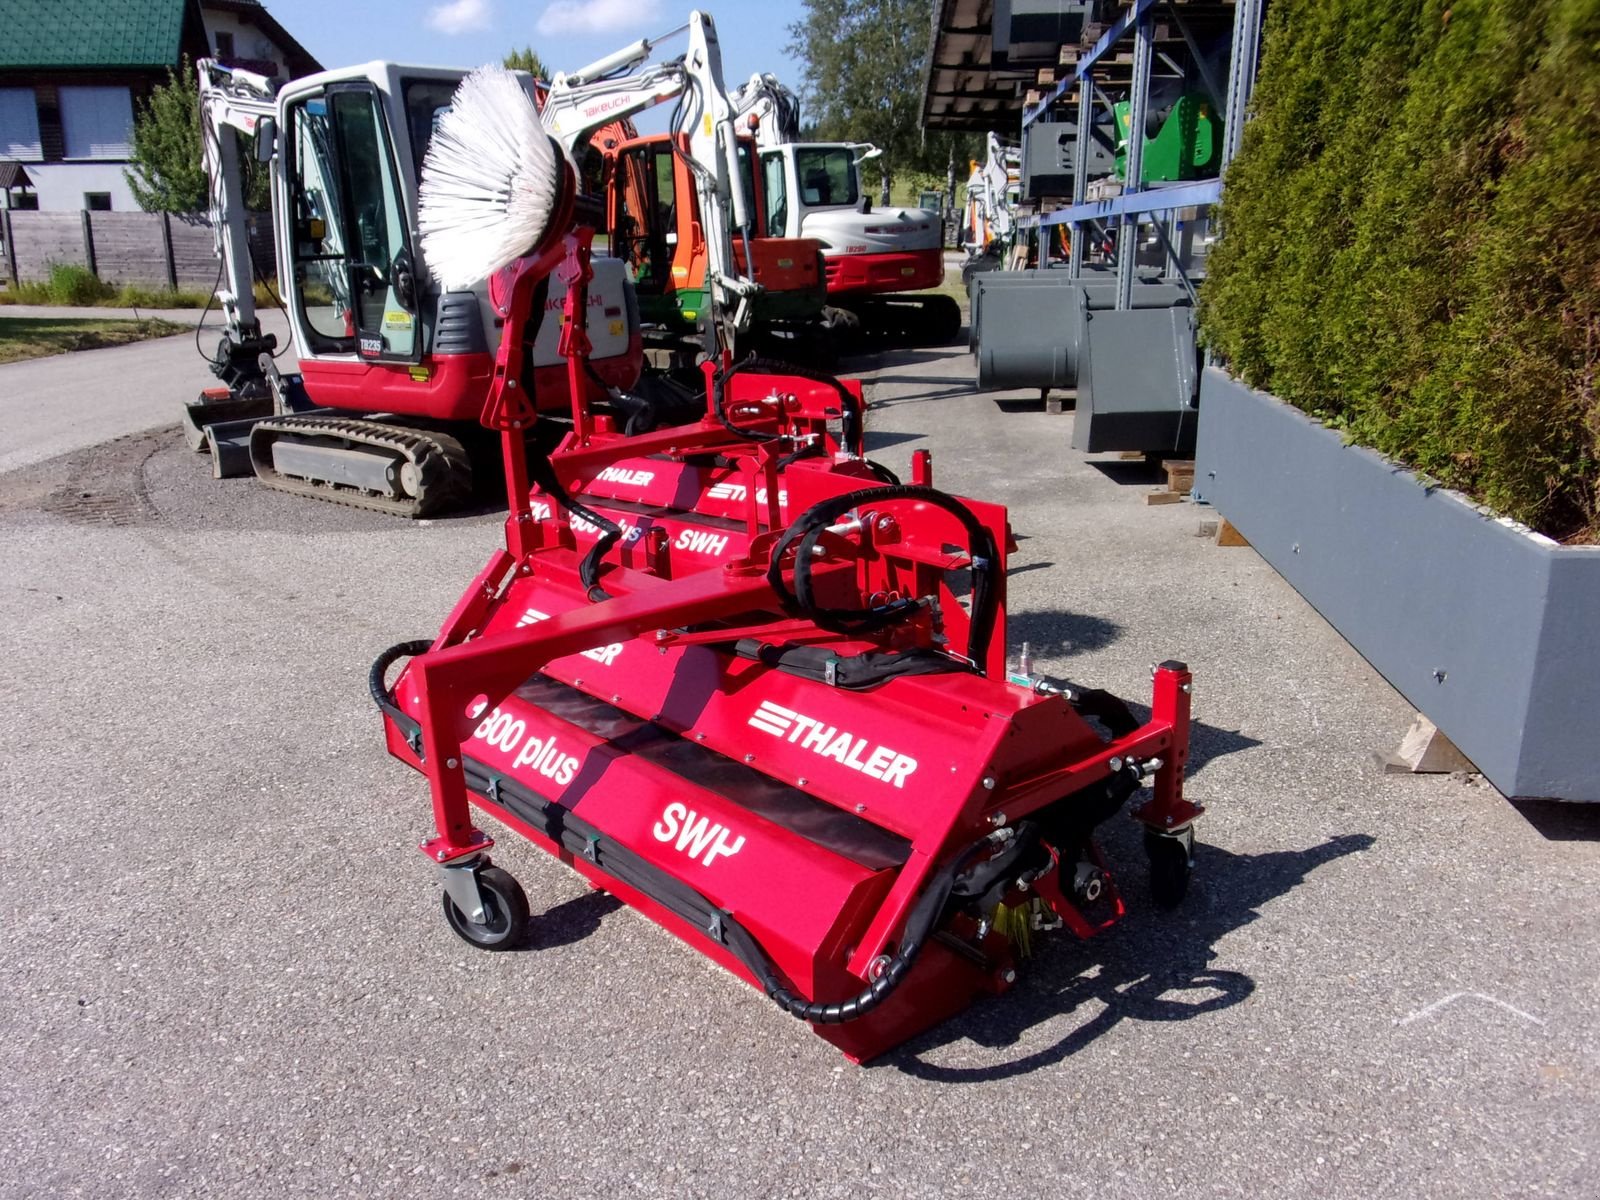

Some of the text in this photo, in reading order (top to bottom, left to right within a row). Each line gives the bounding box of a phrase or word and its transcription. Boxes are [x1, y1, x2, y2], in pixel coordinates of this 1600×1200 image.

[360, 339, 381, 352] TB235
[675, 529, 728, 556] SWH
[512, 736, 579, 785] plus
[788, 704, 918, 789] THALER
[653, 802, 746, 867] SWH
